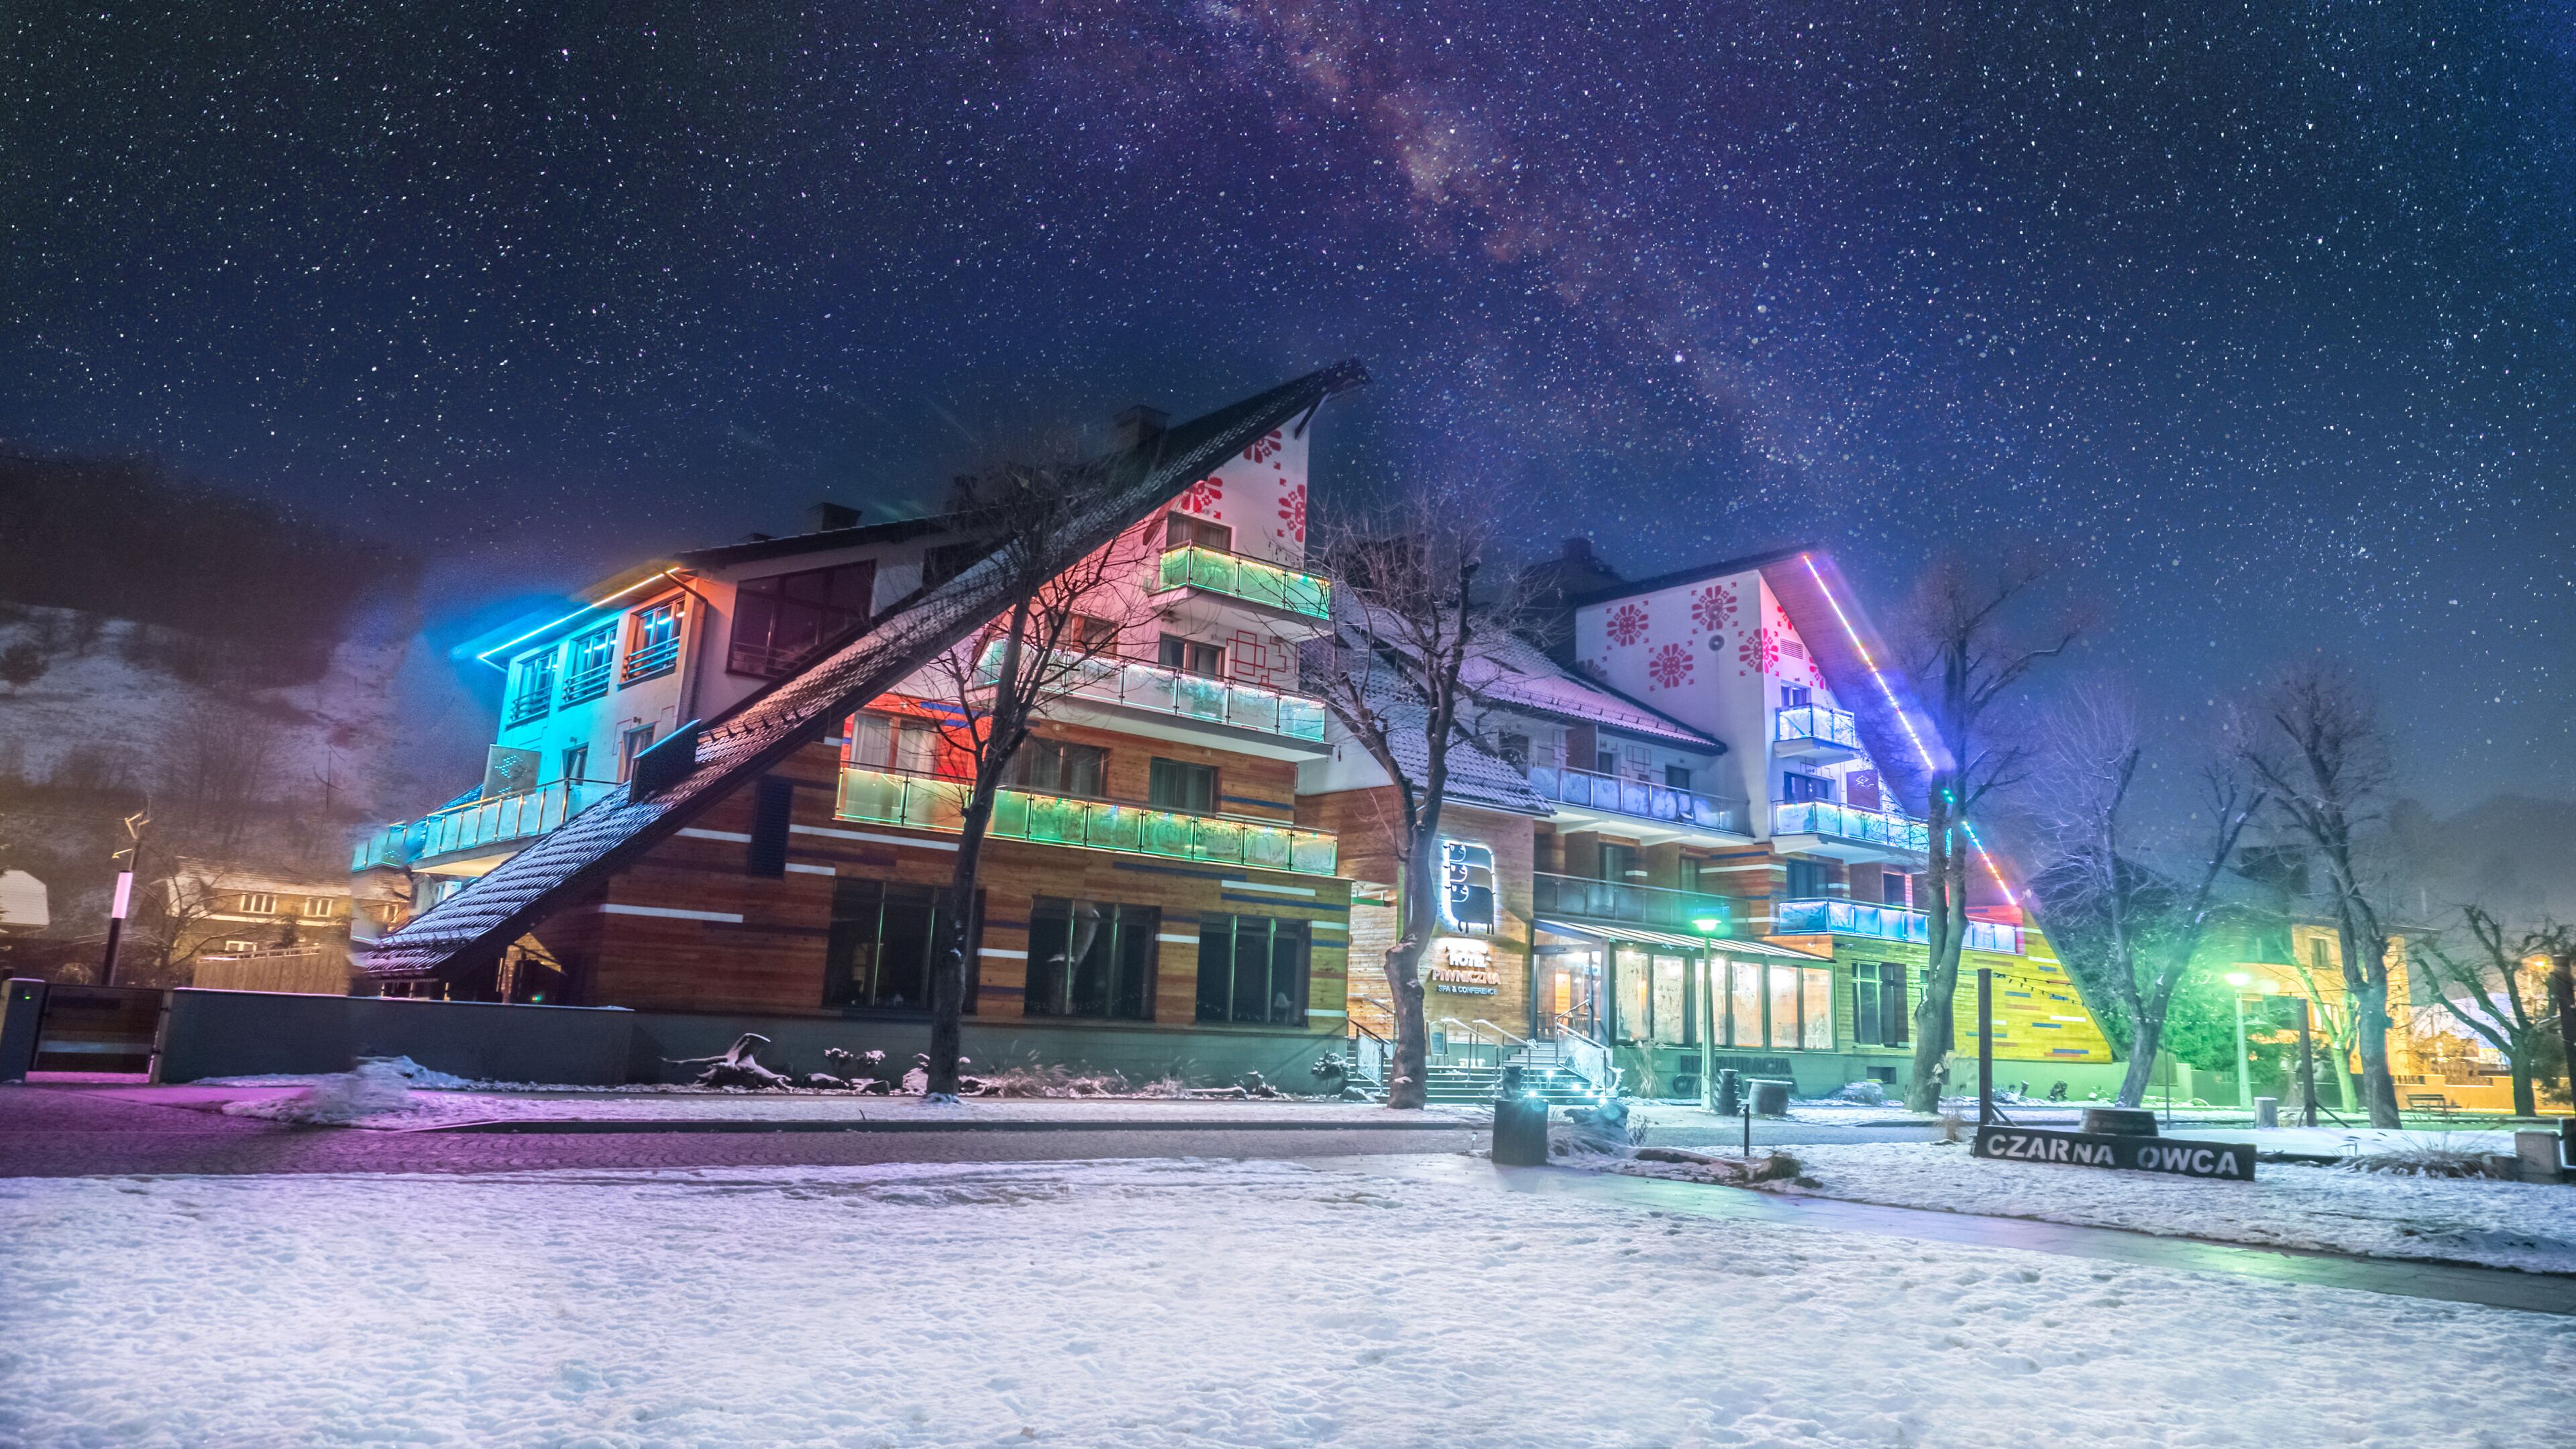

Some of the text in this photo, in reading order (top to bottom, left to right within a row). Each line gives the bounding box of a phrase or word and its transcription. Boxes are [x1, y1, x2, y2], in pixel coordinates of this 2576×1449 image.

[1449, 955, 1487, 967] HOTEL
[1432, 969, 1501, 985] PIWNICZNA
[1458, 987, 1498, 995] CONFERENCE
[1987, 1134, 2239, 1175] CZARNA OWCA
